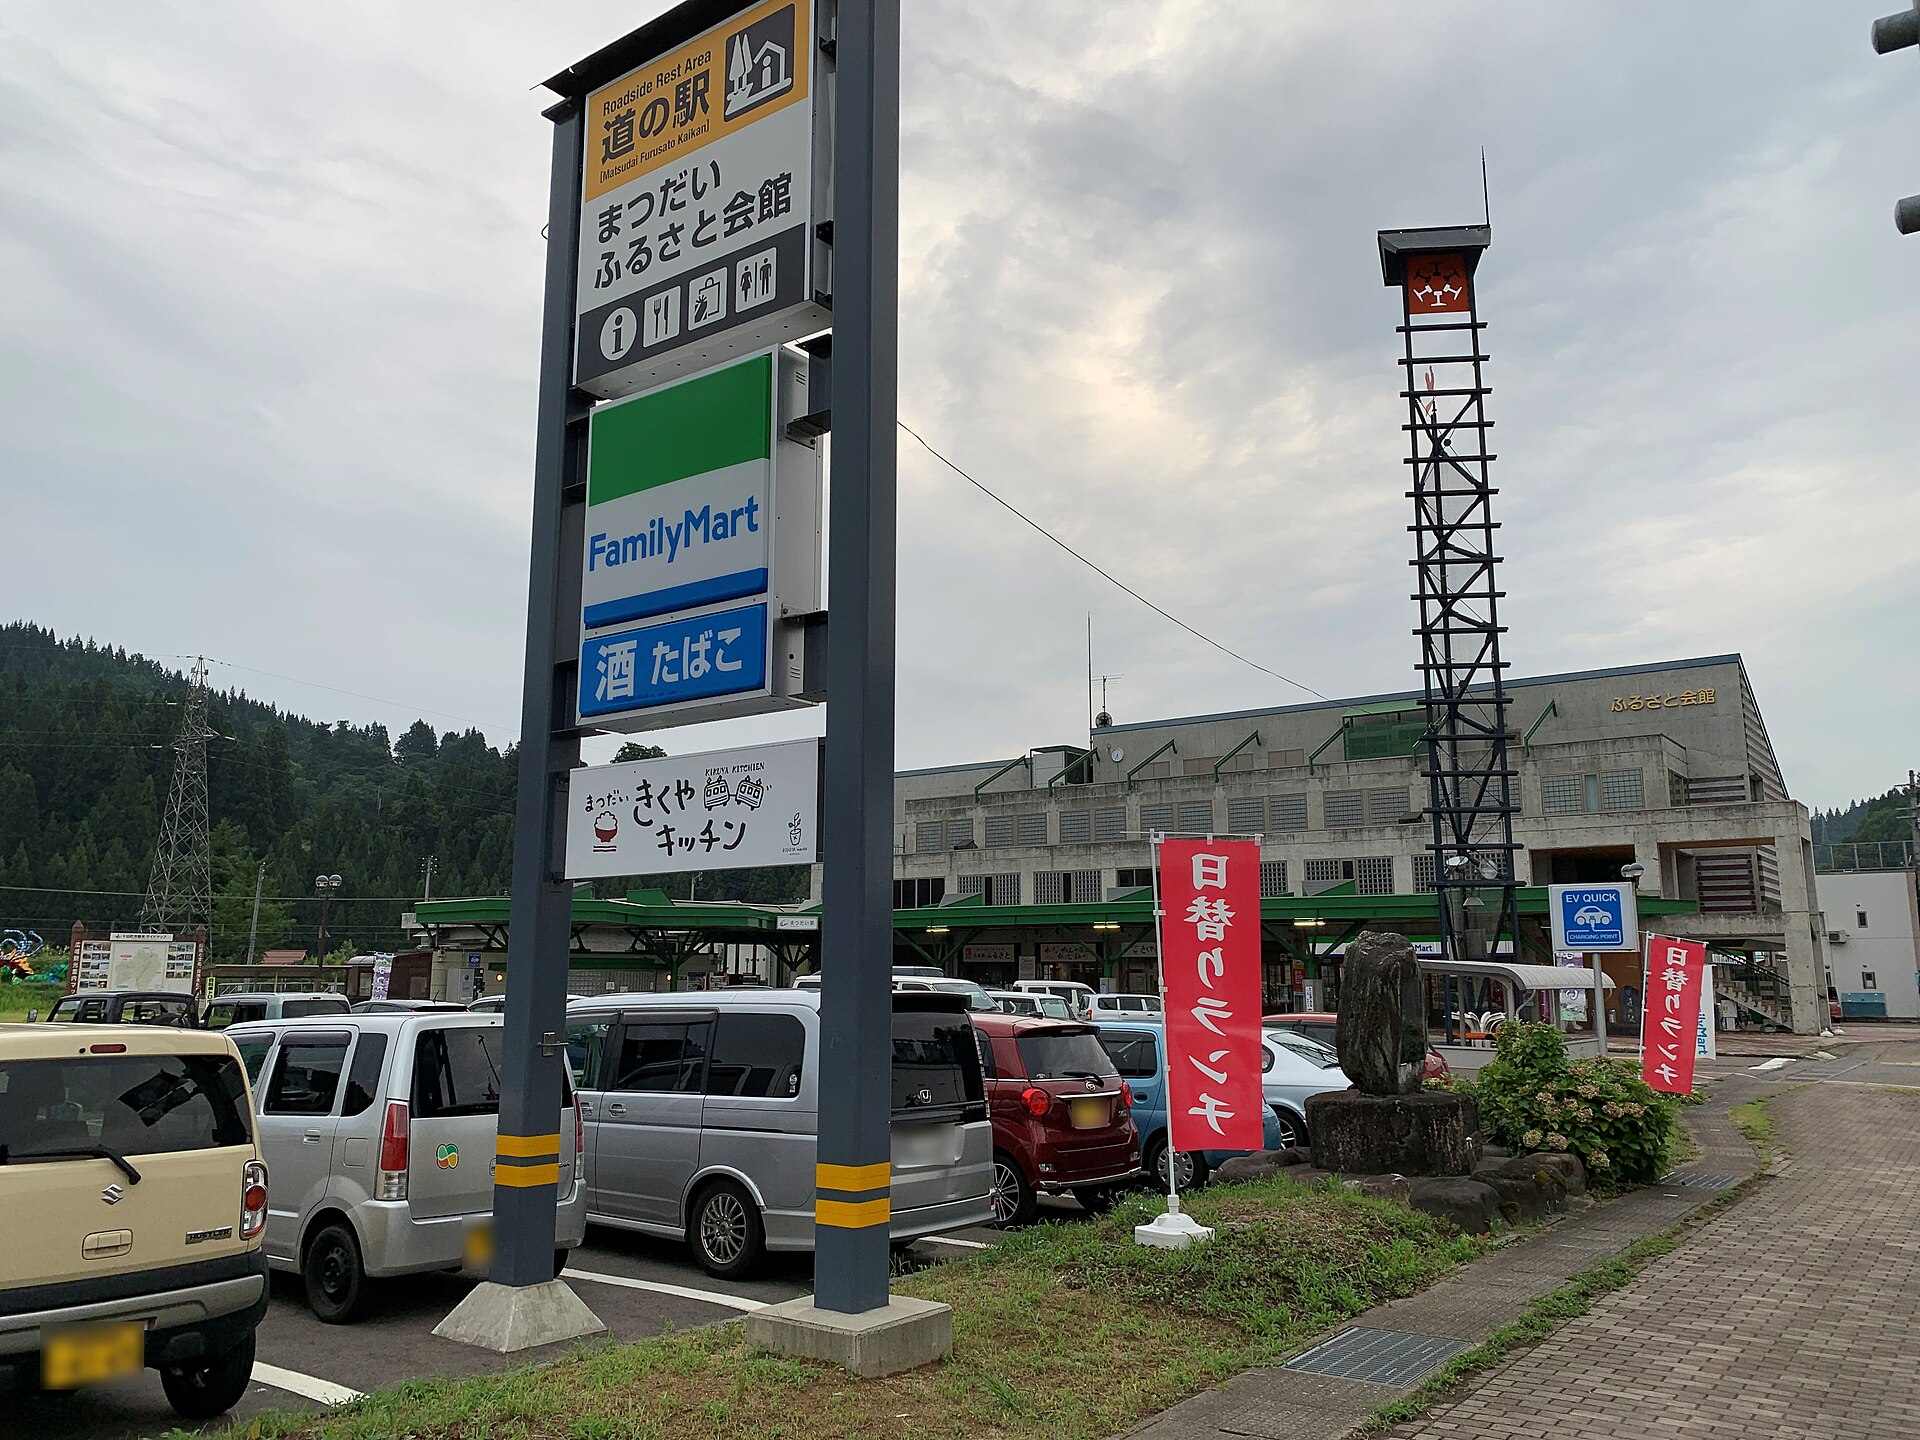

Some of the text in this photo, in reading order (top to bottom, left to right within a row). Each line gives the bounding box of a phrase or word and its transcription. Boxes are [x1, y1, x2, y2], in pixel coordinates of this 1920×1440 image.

[603, 50, 712, 117] Roadside Rest Area
[601, 69, 711, 165] 道の駅
[640, 140, 676, 164] Furusato
[598, 159, 722, 244] まつだい
[594, 171, 792, 289] ふるさと会館
[589, 495, 759, 572] FamilyMart
[595, 627, 742, 702] 酒 たばこ
[1611, 687, 1715, 712] ふるさと会館
[585, 778, 696, 827] まつだい きくや
[655, 819, 747, 856] キッチン
[1566, 893, 1617, 903] EV QUICK
[1696, 1010, 1708, 1055] ilyMart
[190, 1230, 230, 1240] HUSTLER
